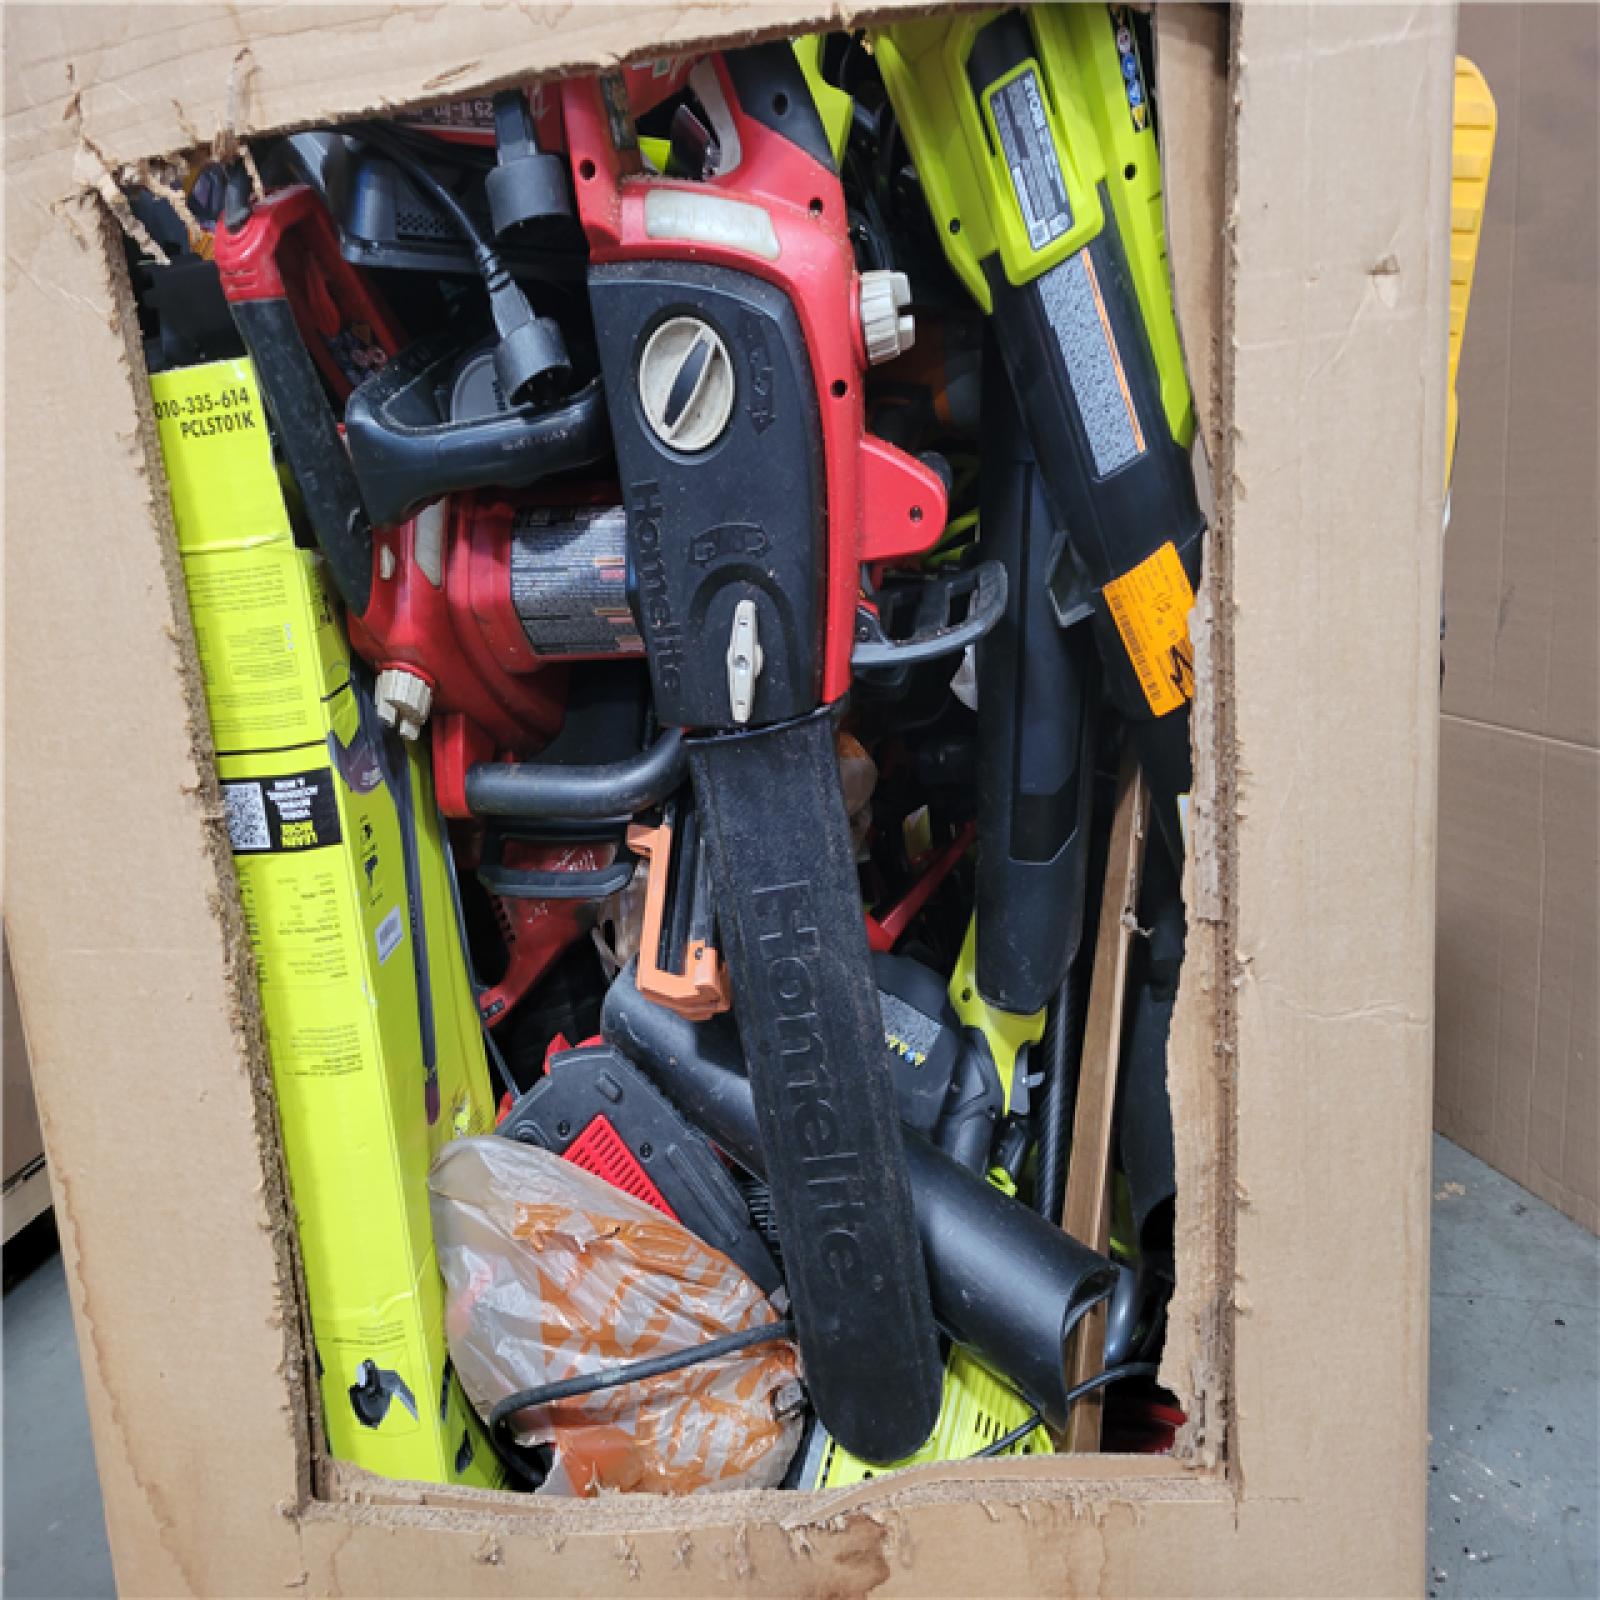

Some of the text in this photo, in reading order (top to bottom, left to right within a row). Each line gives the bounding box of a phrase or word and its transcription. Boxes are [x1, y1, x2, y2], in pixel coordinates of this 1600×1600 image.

[180, 410, 256, 439] PCLST01K
[630, 479, 684, 692] Homelite
[752, 879, 867, 1290] Homelite
